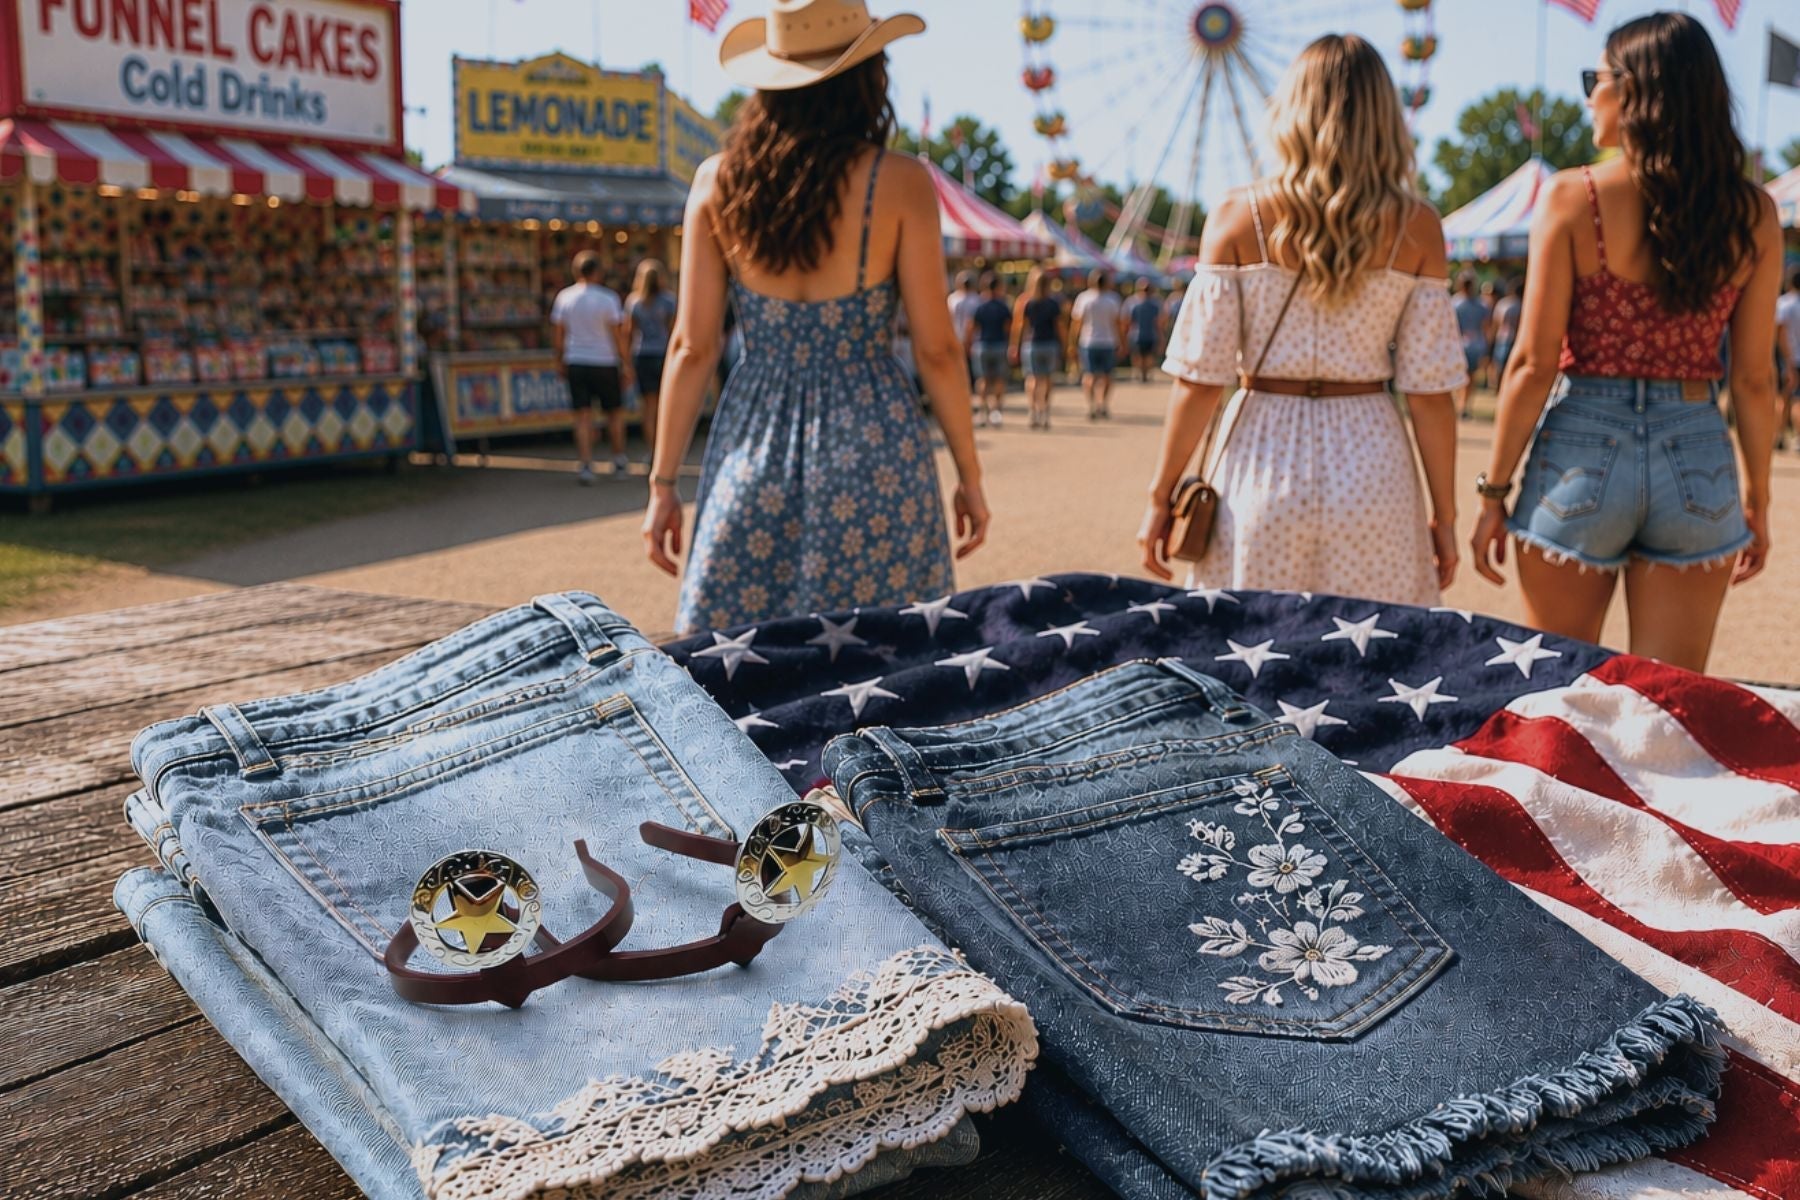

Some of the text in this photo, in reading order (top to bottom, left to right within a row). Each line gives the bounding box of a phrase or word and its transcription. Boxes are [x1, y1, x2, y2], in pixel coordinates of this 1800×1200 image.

[248, 4, 381, 84] CAKES
[120, 55, 327, 124] Cold Drinks
[467, 89, 654, 141] LEMONADE
